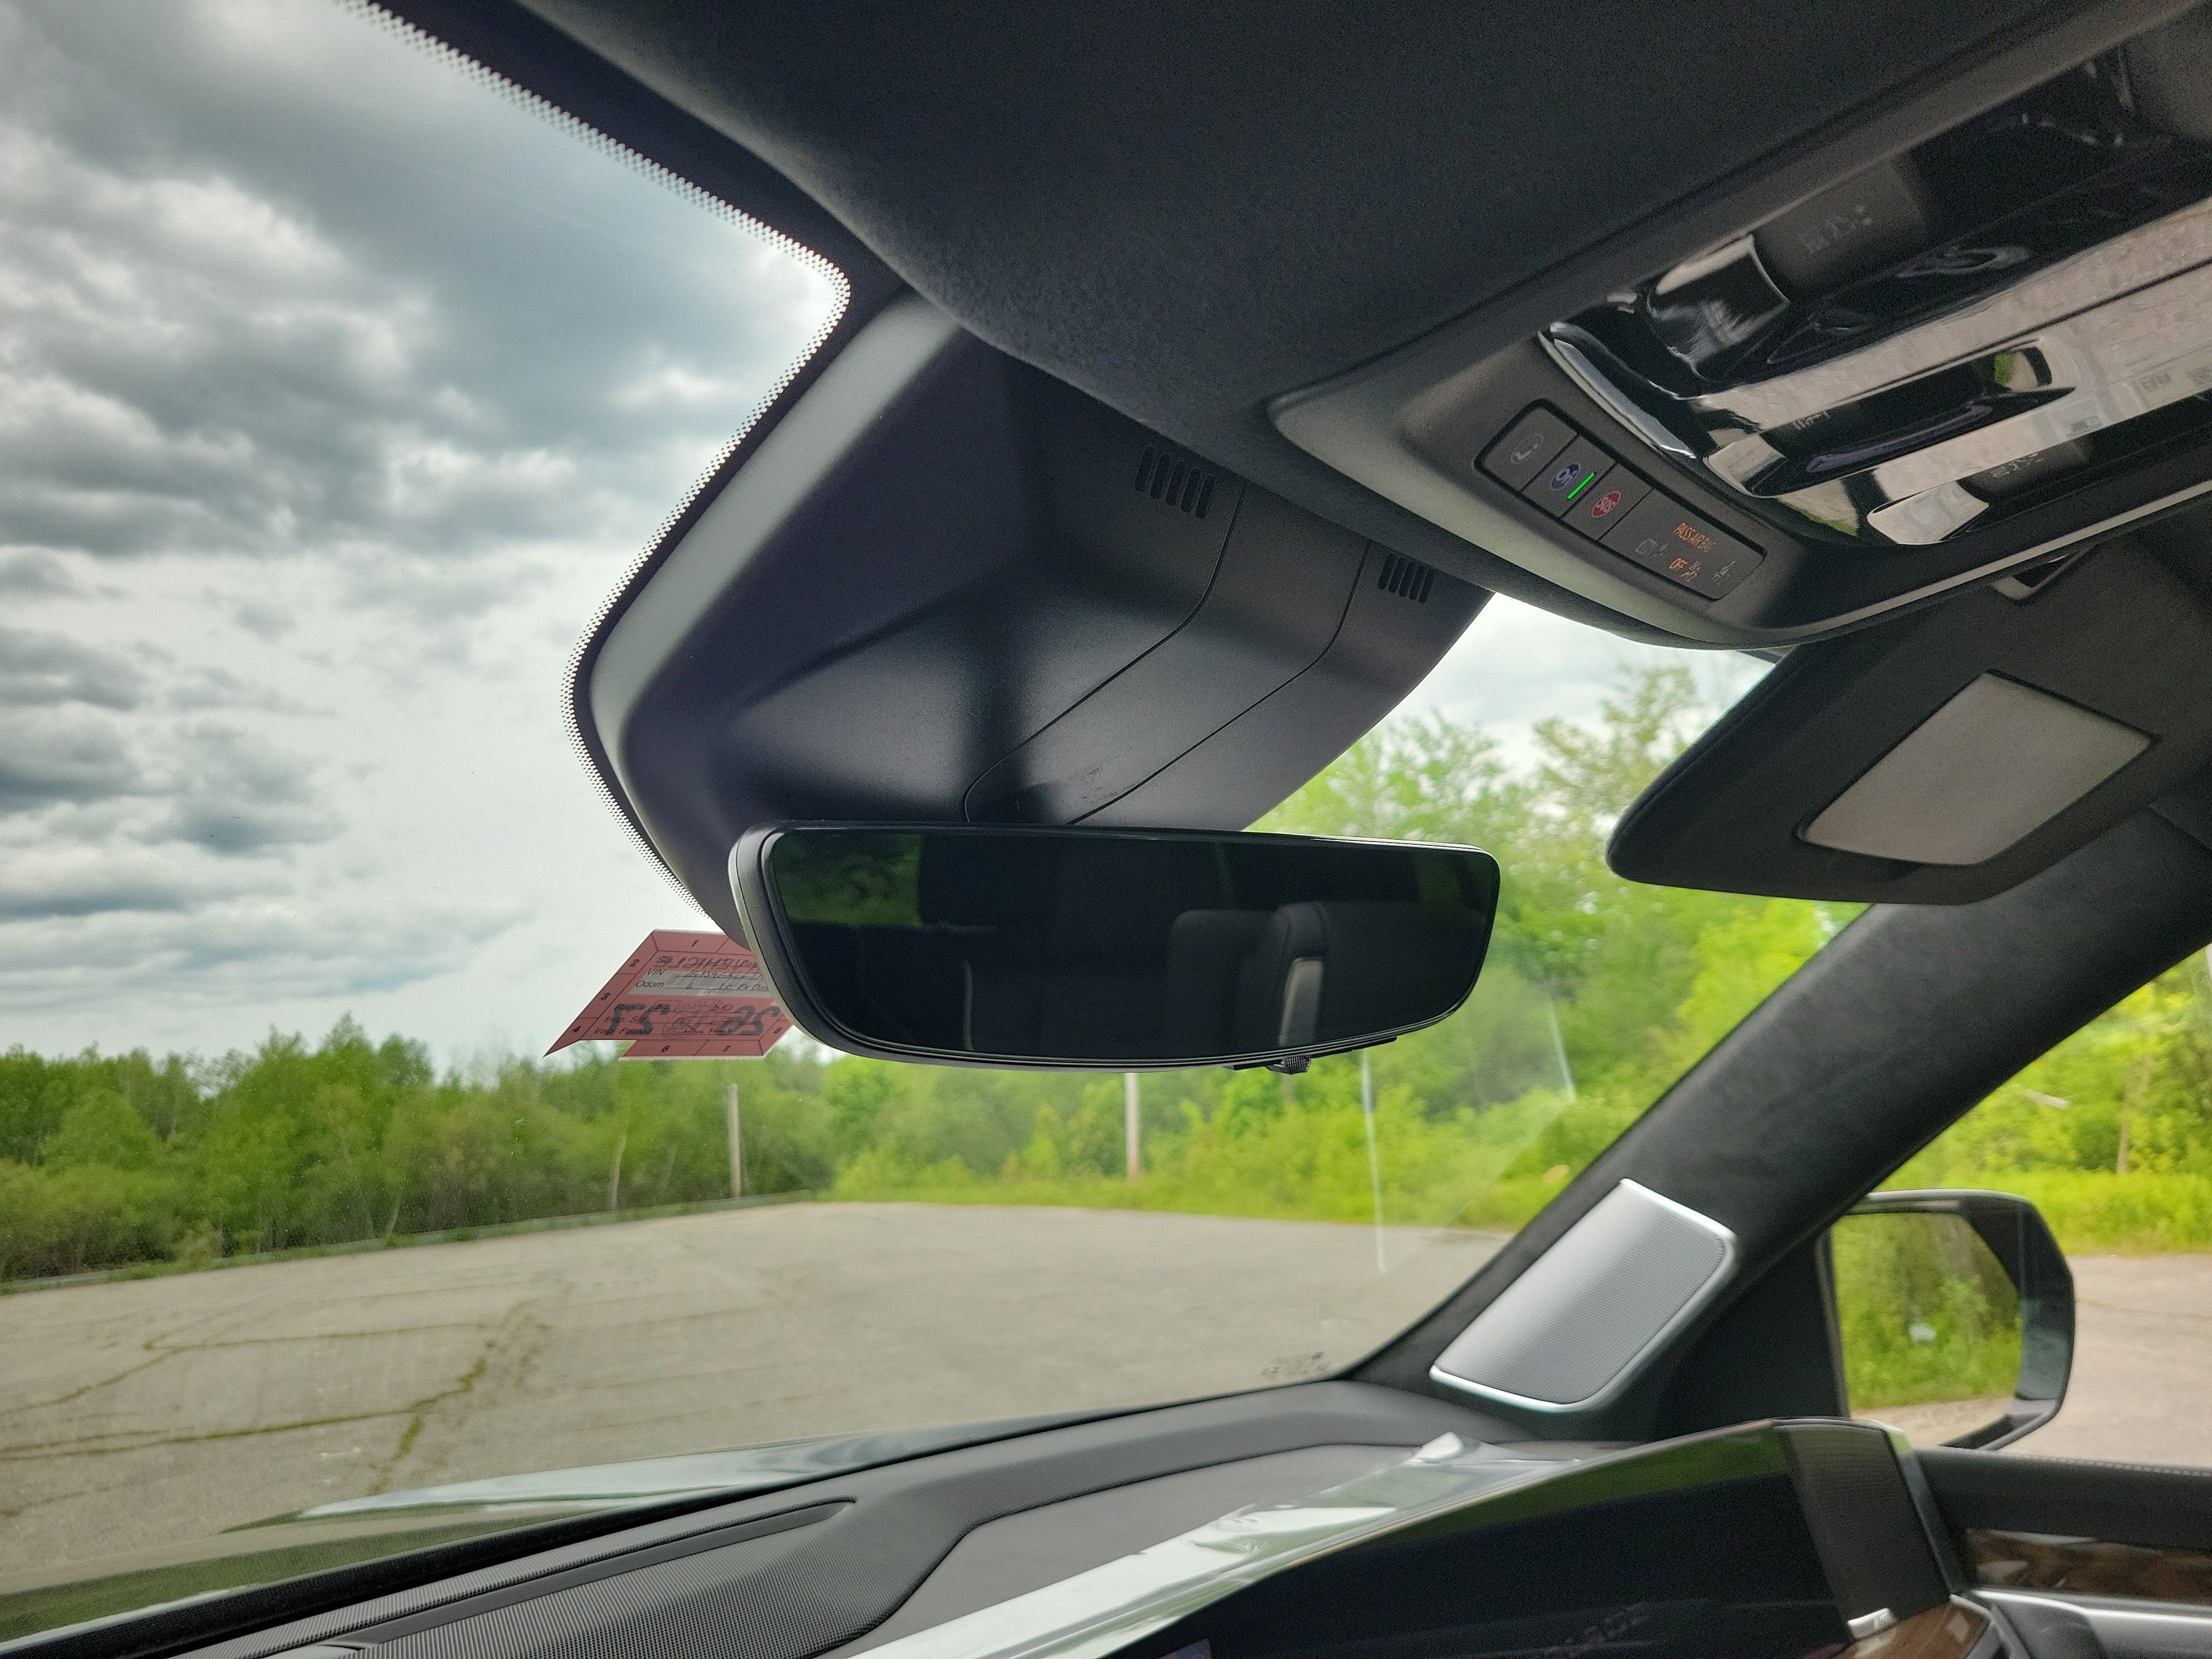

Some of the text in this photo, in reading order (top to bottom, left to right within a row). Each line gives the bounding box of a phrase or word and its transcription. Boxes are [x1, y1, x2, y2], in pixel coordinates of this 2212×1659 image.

[1596, 496, 1616, 512] SOS
[1669, 558, 1688, 571] OFF
[635, 980, 665, 988] Odom.
[600, 992, 610, 1000] 3
